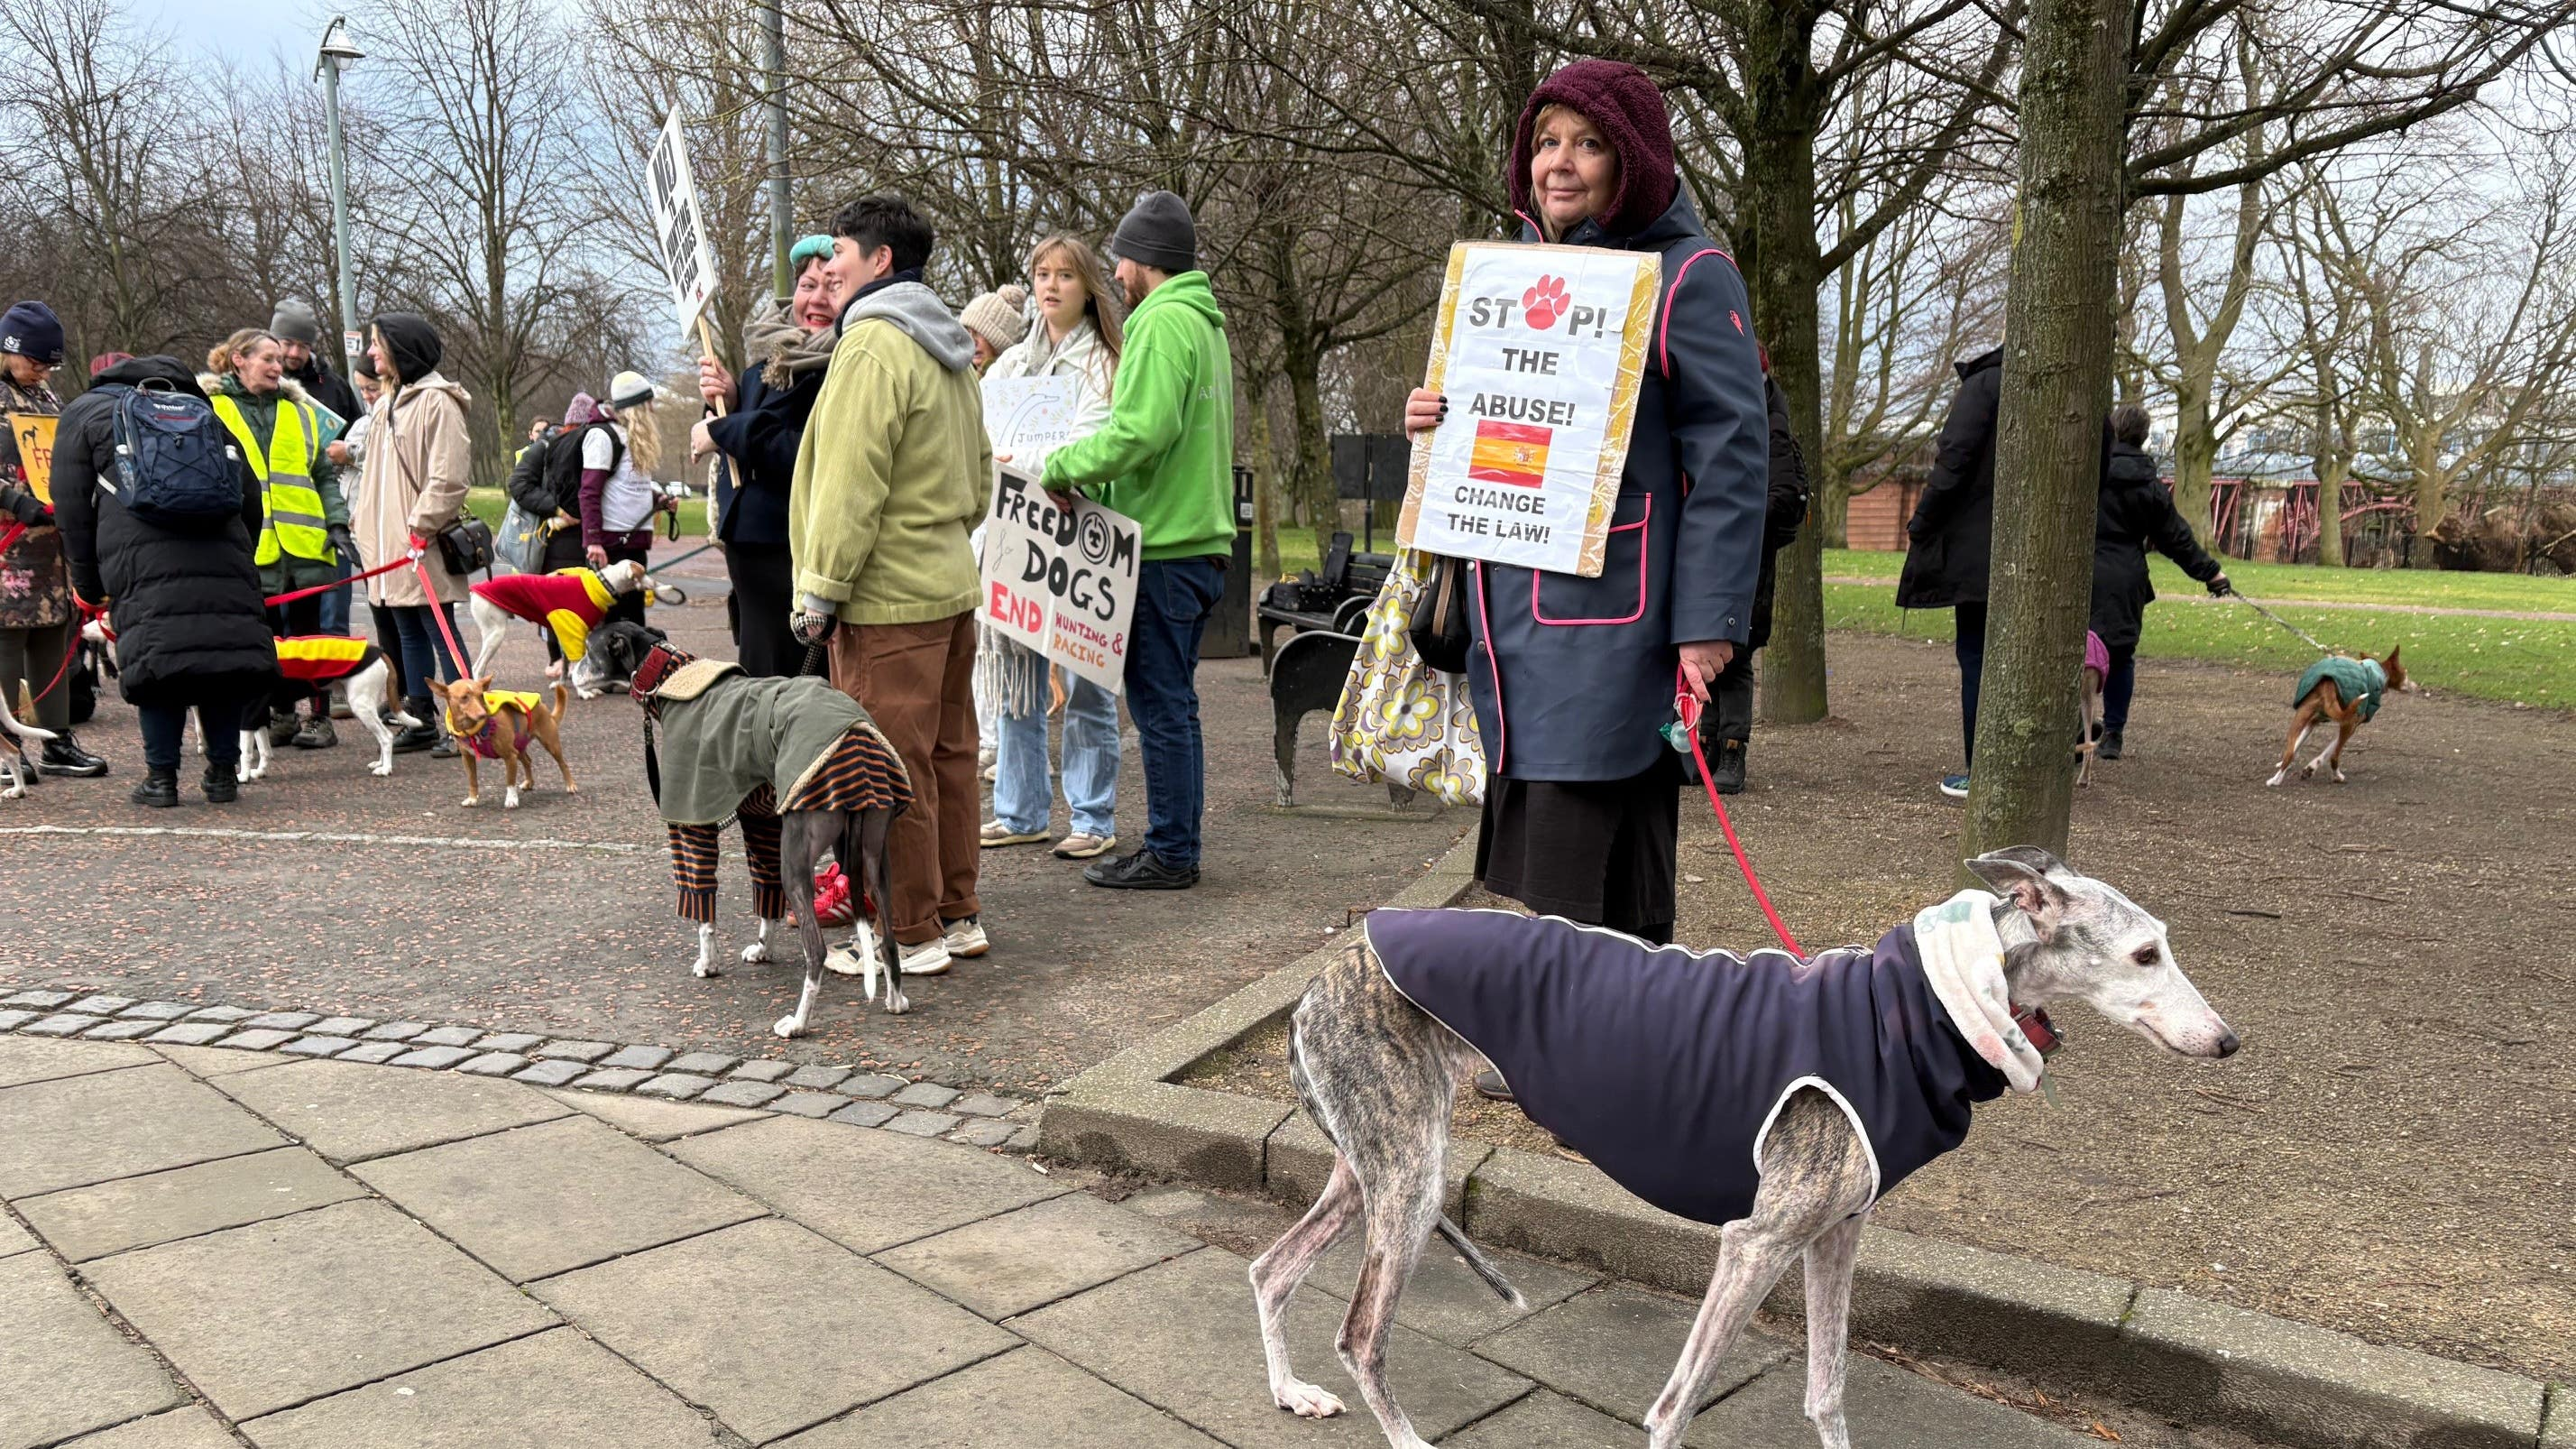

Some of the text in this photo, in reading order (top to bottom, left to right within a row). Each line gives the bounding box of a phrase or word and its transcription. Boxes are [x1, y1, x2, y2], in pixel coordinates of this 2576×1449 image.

[652, 131, 676, 214] NO
[666, 197, 692, 265] HUNTING
[668, 196, 676, 221] TO
[672, 224, 697, 287] WITH DOGS
[680, 254, 698, 303] IN SPAIN
[1502, 347, 1559, 375] THE
[1468, 392, 1577, 426] ABUSE!
[1454, 485, 1546, 515] CHANGE
[997, 472, 1135, 577] FREEDOM
[1448, 513, 1550, 544] THE LAW!
[1021, 539, 1116, 621] DOGS
[989, 580, 1043, 633] END
[1053, 633, 1105, 668] RACING
[1055, 612, 1123, 656] HUNTING &
